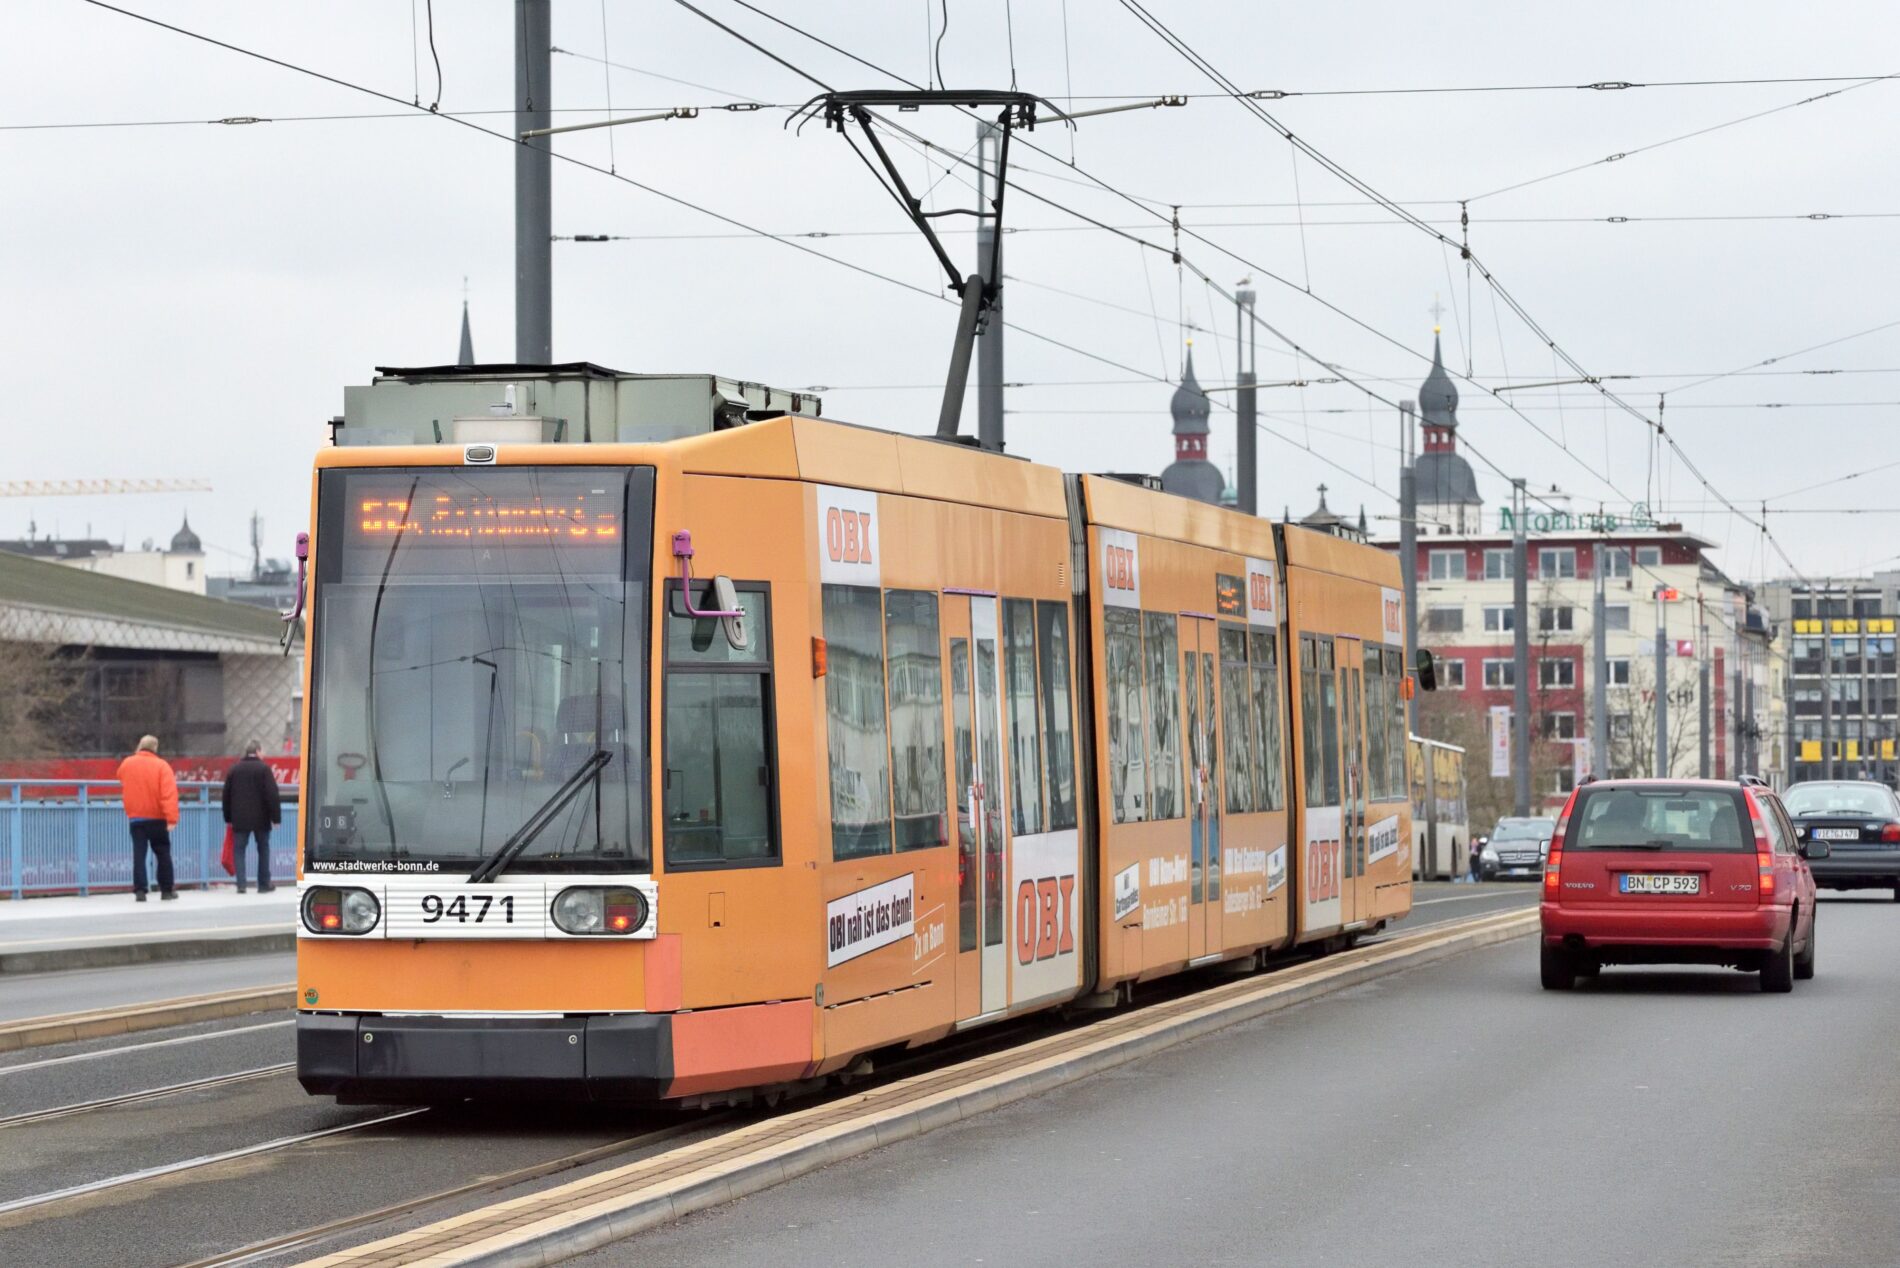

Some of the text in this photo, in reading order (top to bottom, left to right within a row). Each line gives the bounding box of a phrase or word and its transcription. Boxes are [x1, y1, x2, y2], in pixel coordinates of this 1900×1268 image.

[827, 506, 872, 564] OBI
[1106, 545, 1135, 591] OBI
[1251, 572, 1272, 612] OBI
[312, 861, 439, 872] www.stadtwerke-bonn.de
[1309, 840, 1339, 904] OBI
[1628, 877, 1698, 889] BN CP 593
[421, 895, 514, 924] 9471
[830, 889, 911, 952] OBI nah ist das denn!
[1017, 874, 1074, 966] OBI
